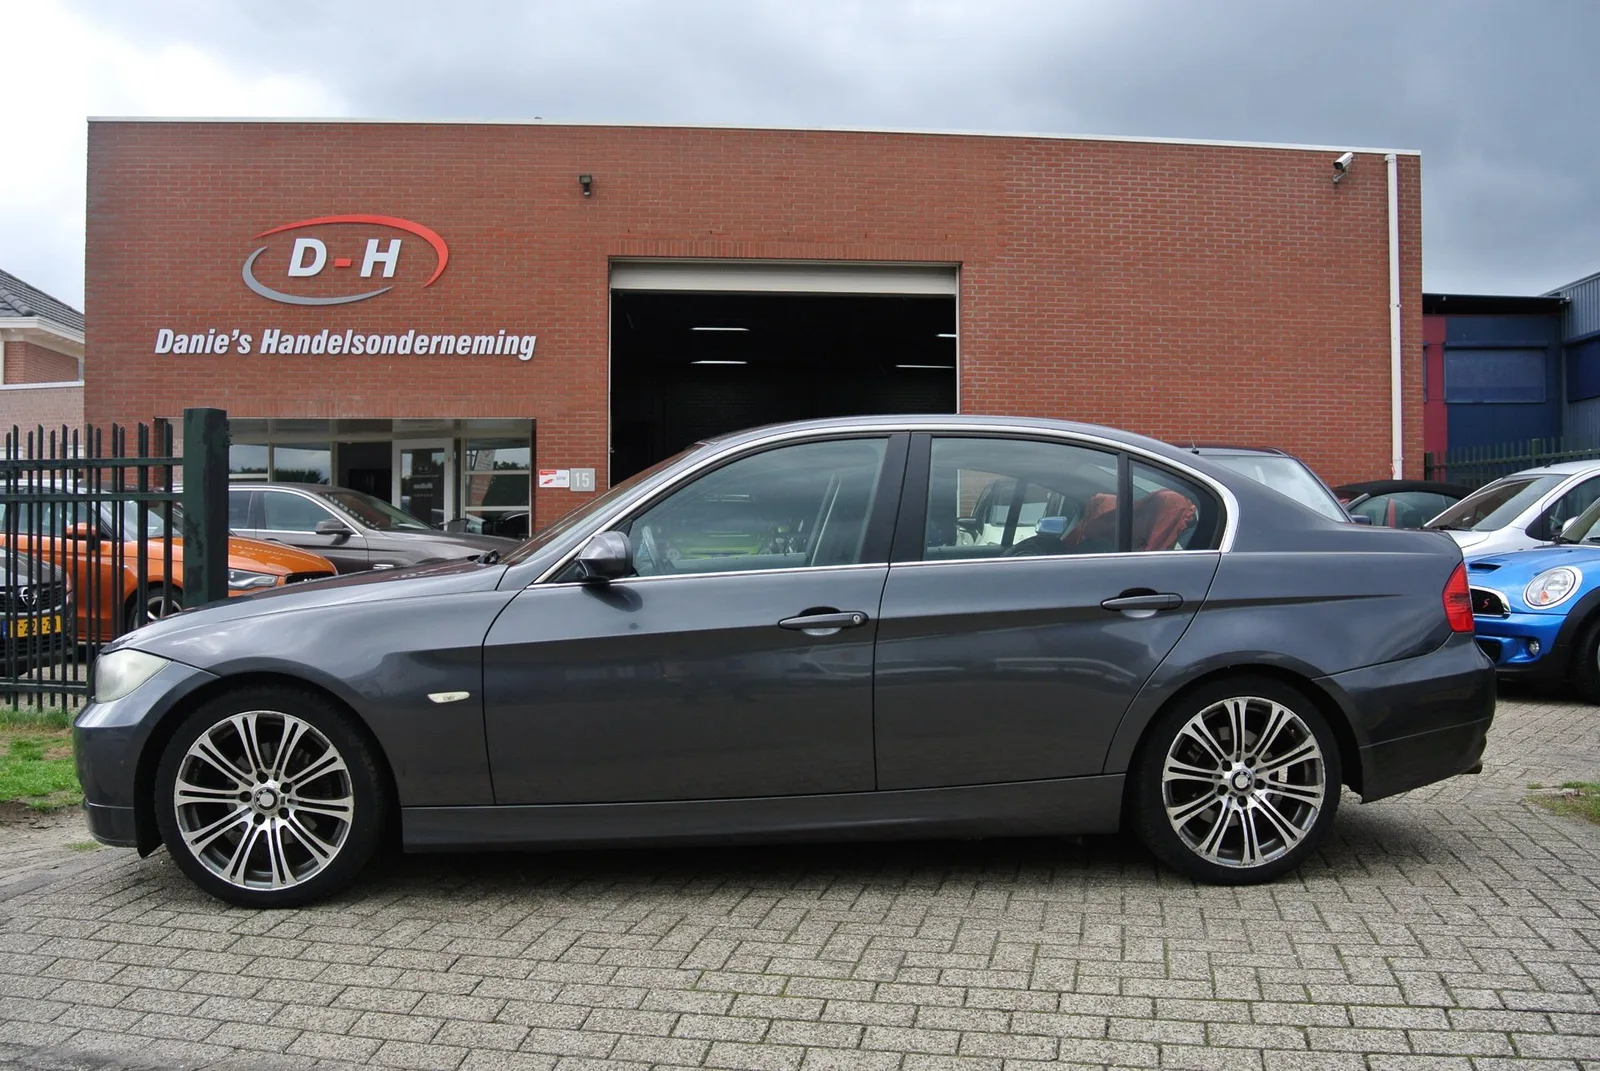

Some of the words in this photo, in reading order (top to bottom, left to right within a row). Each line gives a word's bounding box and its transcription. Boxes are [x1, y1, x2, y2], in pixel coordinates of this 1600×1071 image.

[154, 328, 252, 355] Danie's
[259, 329, 537, 361] Handelsonderneming
[575, 472, 590, 488] 15
